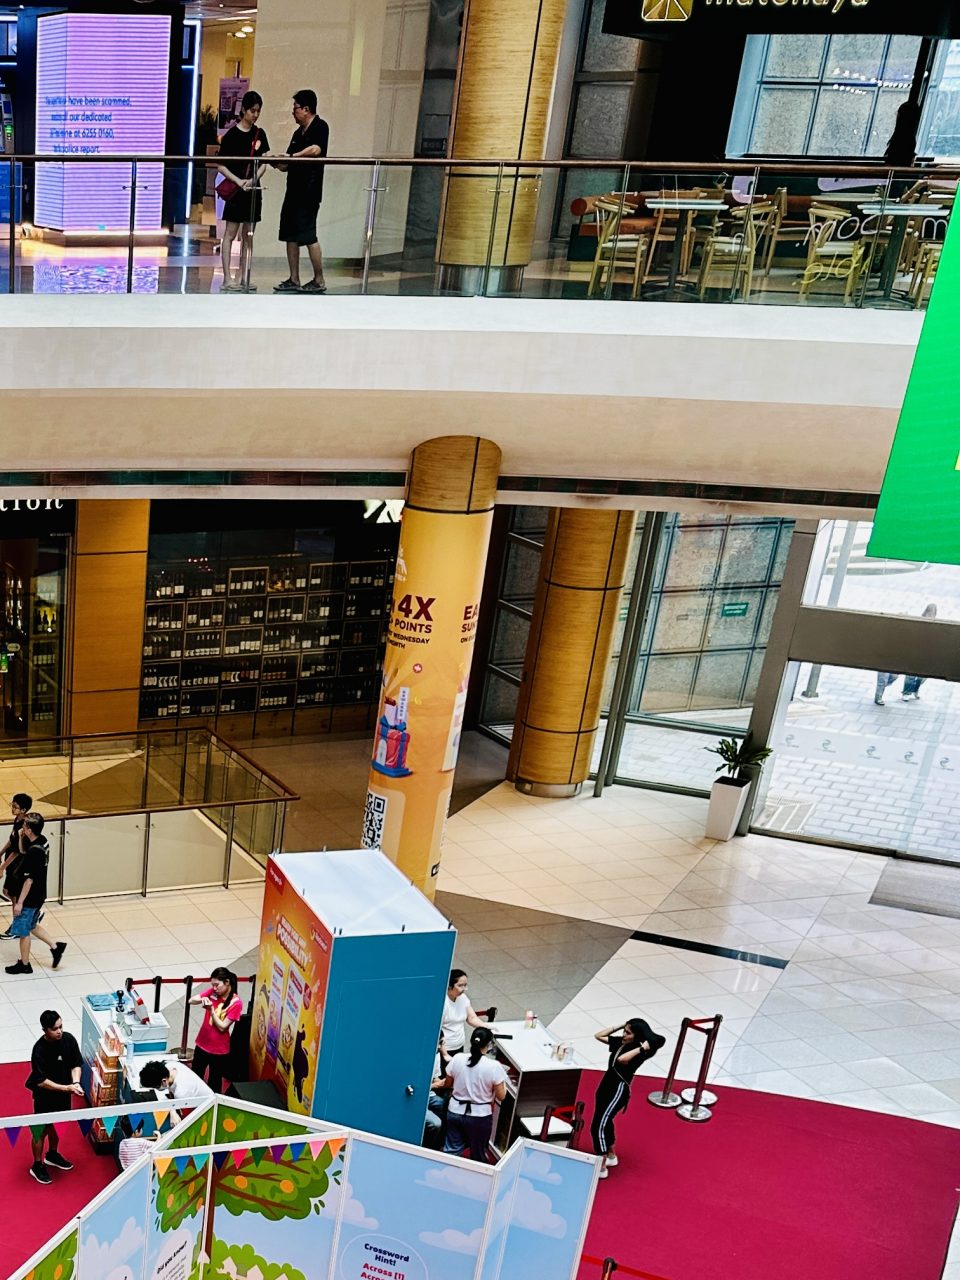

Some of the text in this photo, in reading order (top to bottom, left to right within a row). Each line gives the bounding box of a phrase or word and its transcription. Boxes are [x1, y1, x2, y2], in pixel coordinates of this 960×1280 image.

[398, 594, 436, 621] 4X
[395, 618, 432, 633] POINTS
[393, 631, 430, 644] WEDNESDAY
[364, 1243, 410, 1262] Crossword
[375, 1254, 396, 1266] Hint!
[363, 1263, 392, 1277] Across
